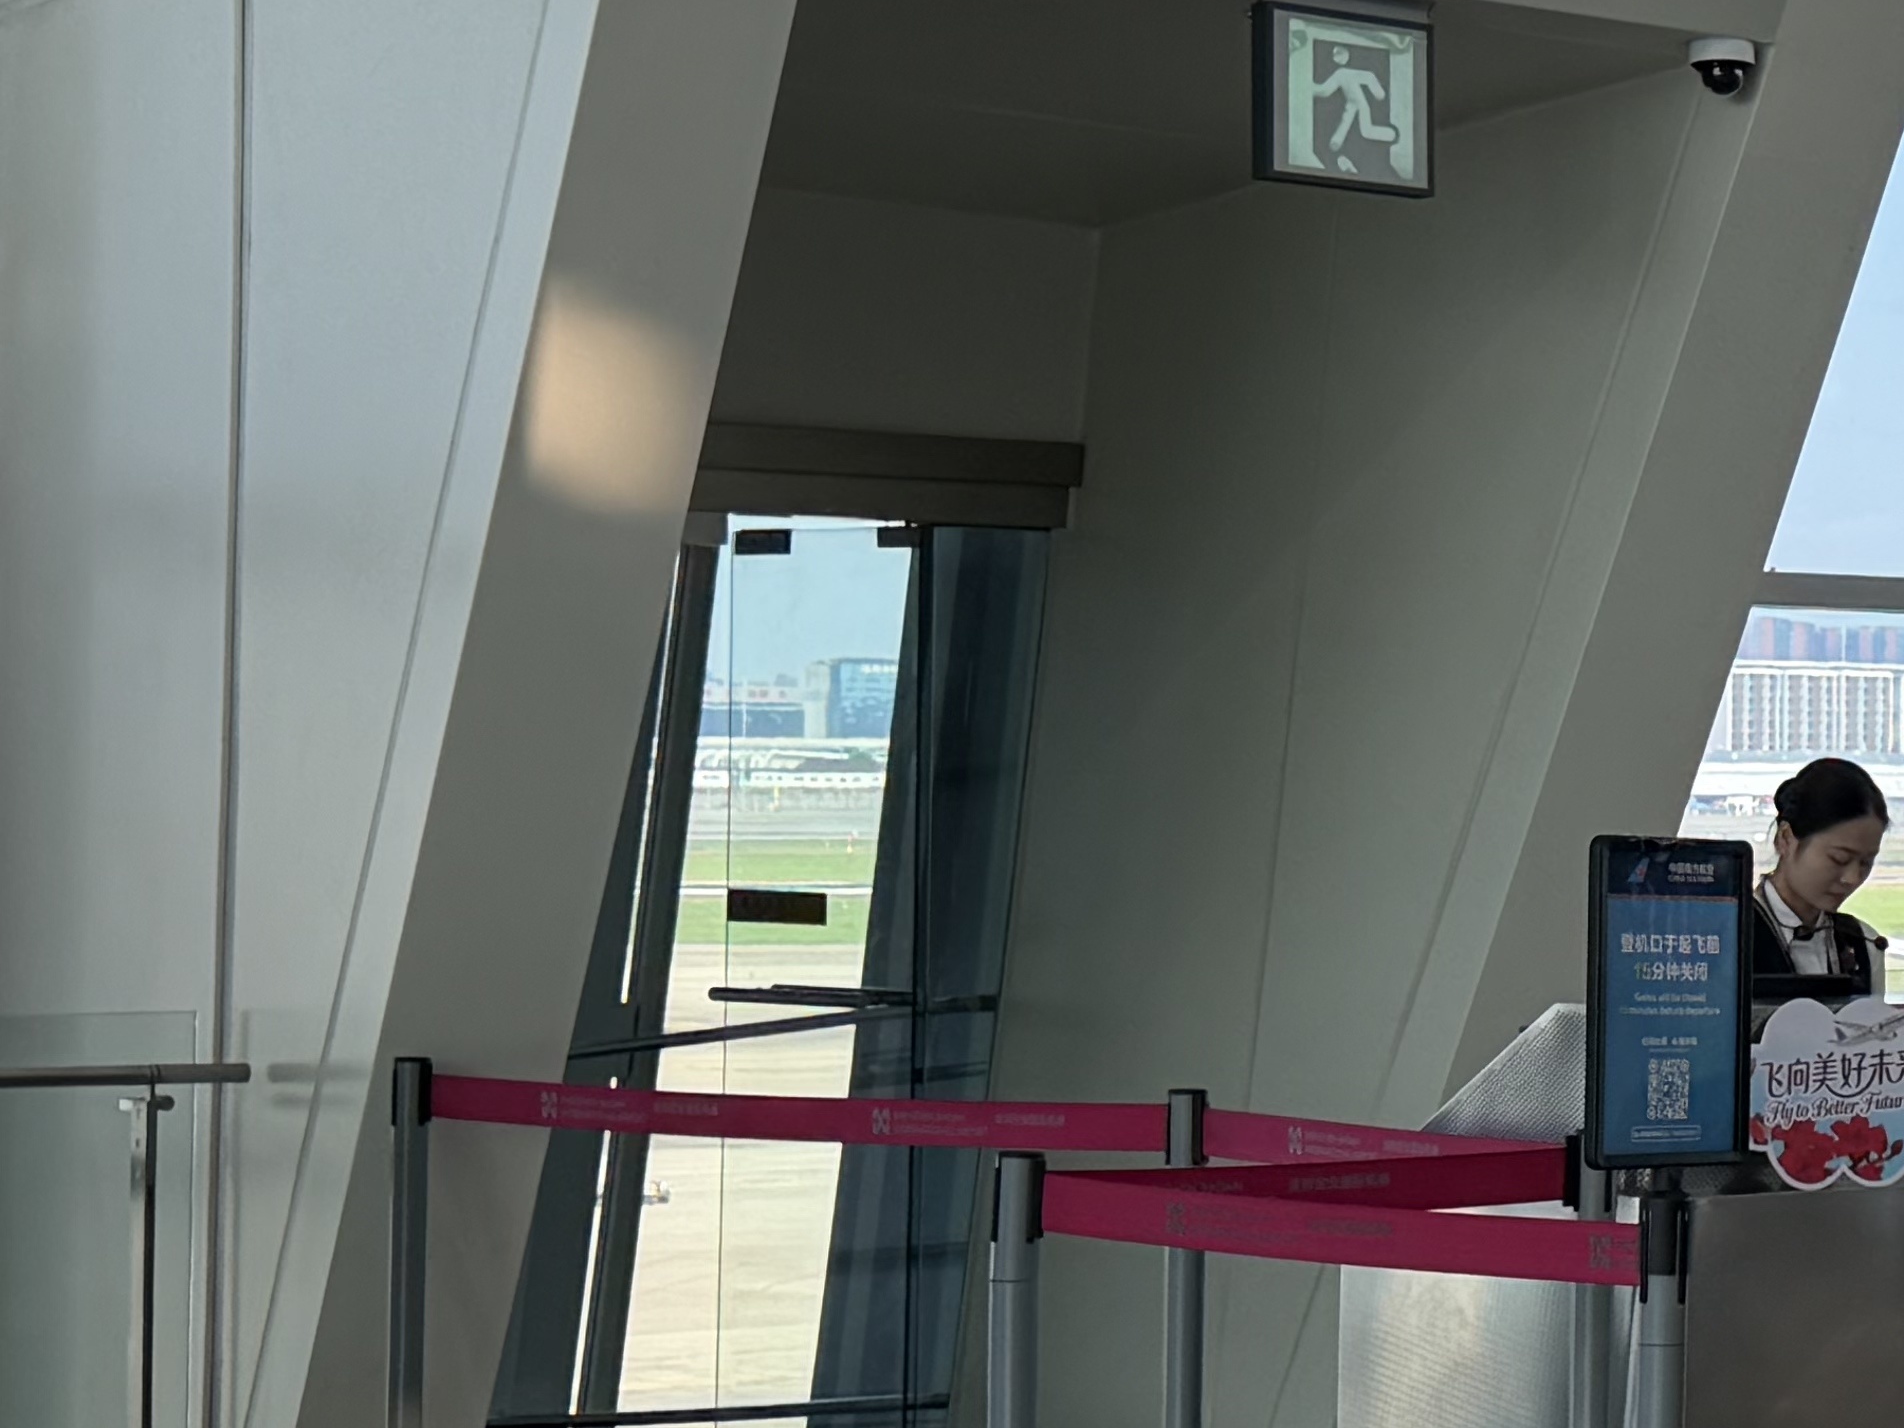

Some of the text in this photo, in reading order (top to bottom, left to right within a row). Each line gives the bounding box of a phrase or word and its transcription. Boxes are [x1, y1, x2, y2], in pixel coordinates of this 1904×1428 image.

[1766, 1099, 1794, 1123] Fly
[1795, 1102, 1809, 1118] to
[1812, 1097, 1860, 1118] Better
